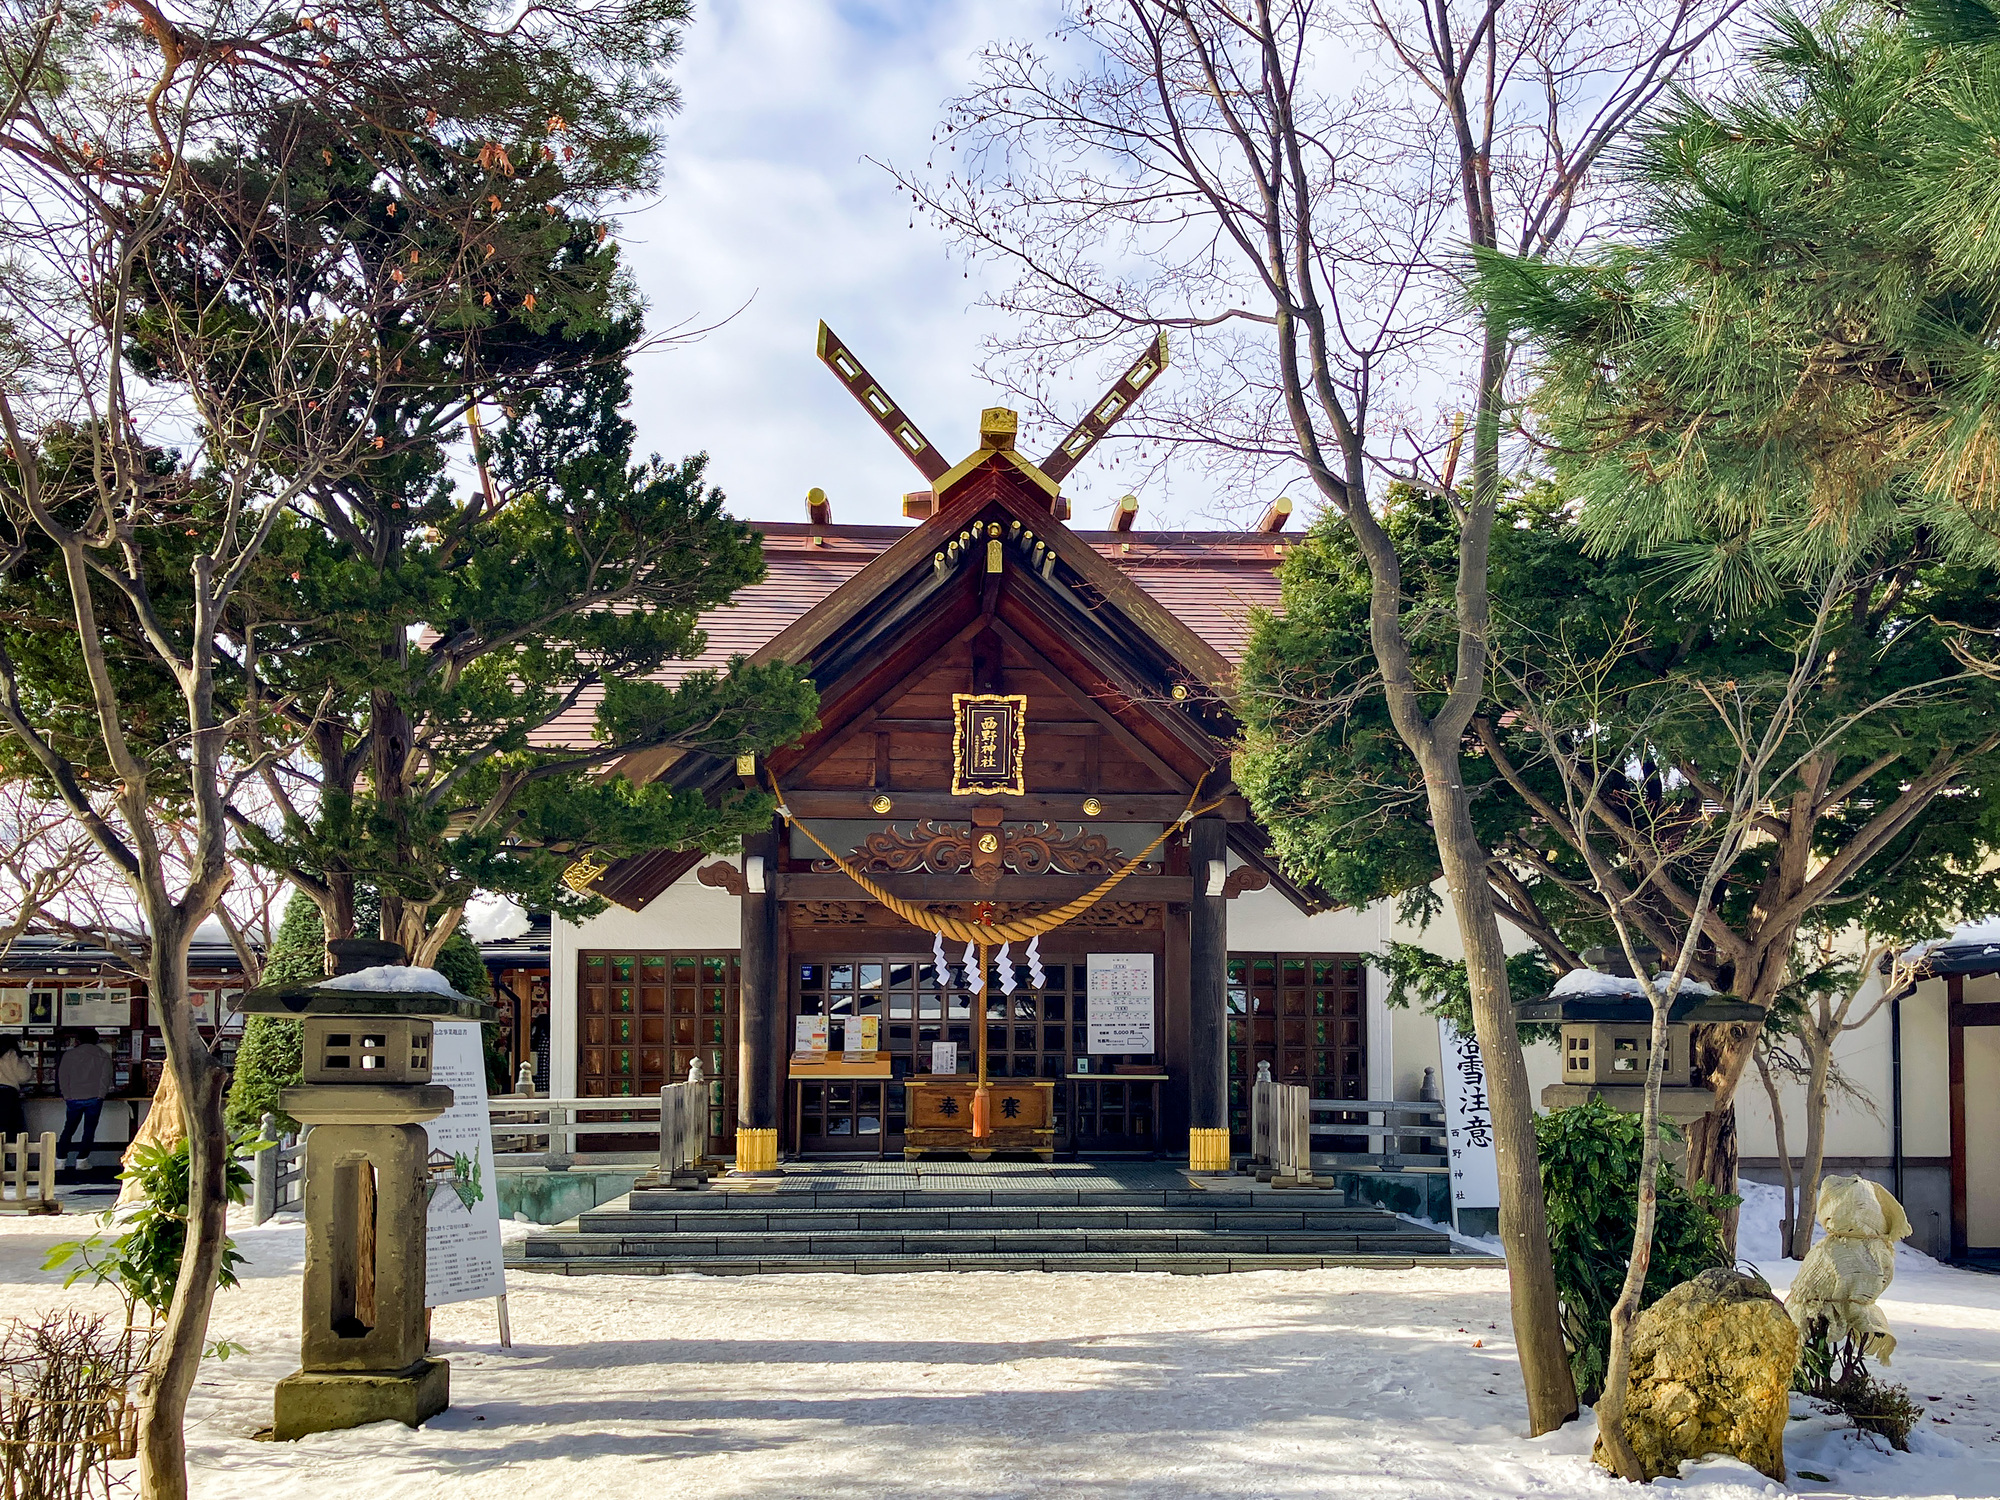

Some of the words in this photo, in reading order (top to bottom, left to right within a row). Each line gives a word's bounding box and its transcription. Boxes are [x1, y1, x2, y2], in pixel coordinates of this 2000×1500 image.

[980, 716, 998, 768] 西野神社
[938, 1096, 959, 1118] 奉
[1450, 1128, 1465, 1200] 西野神社
